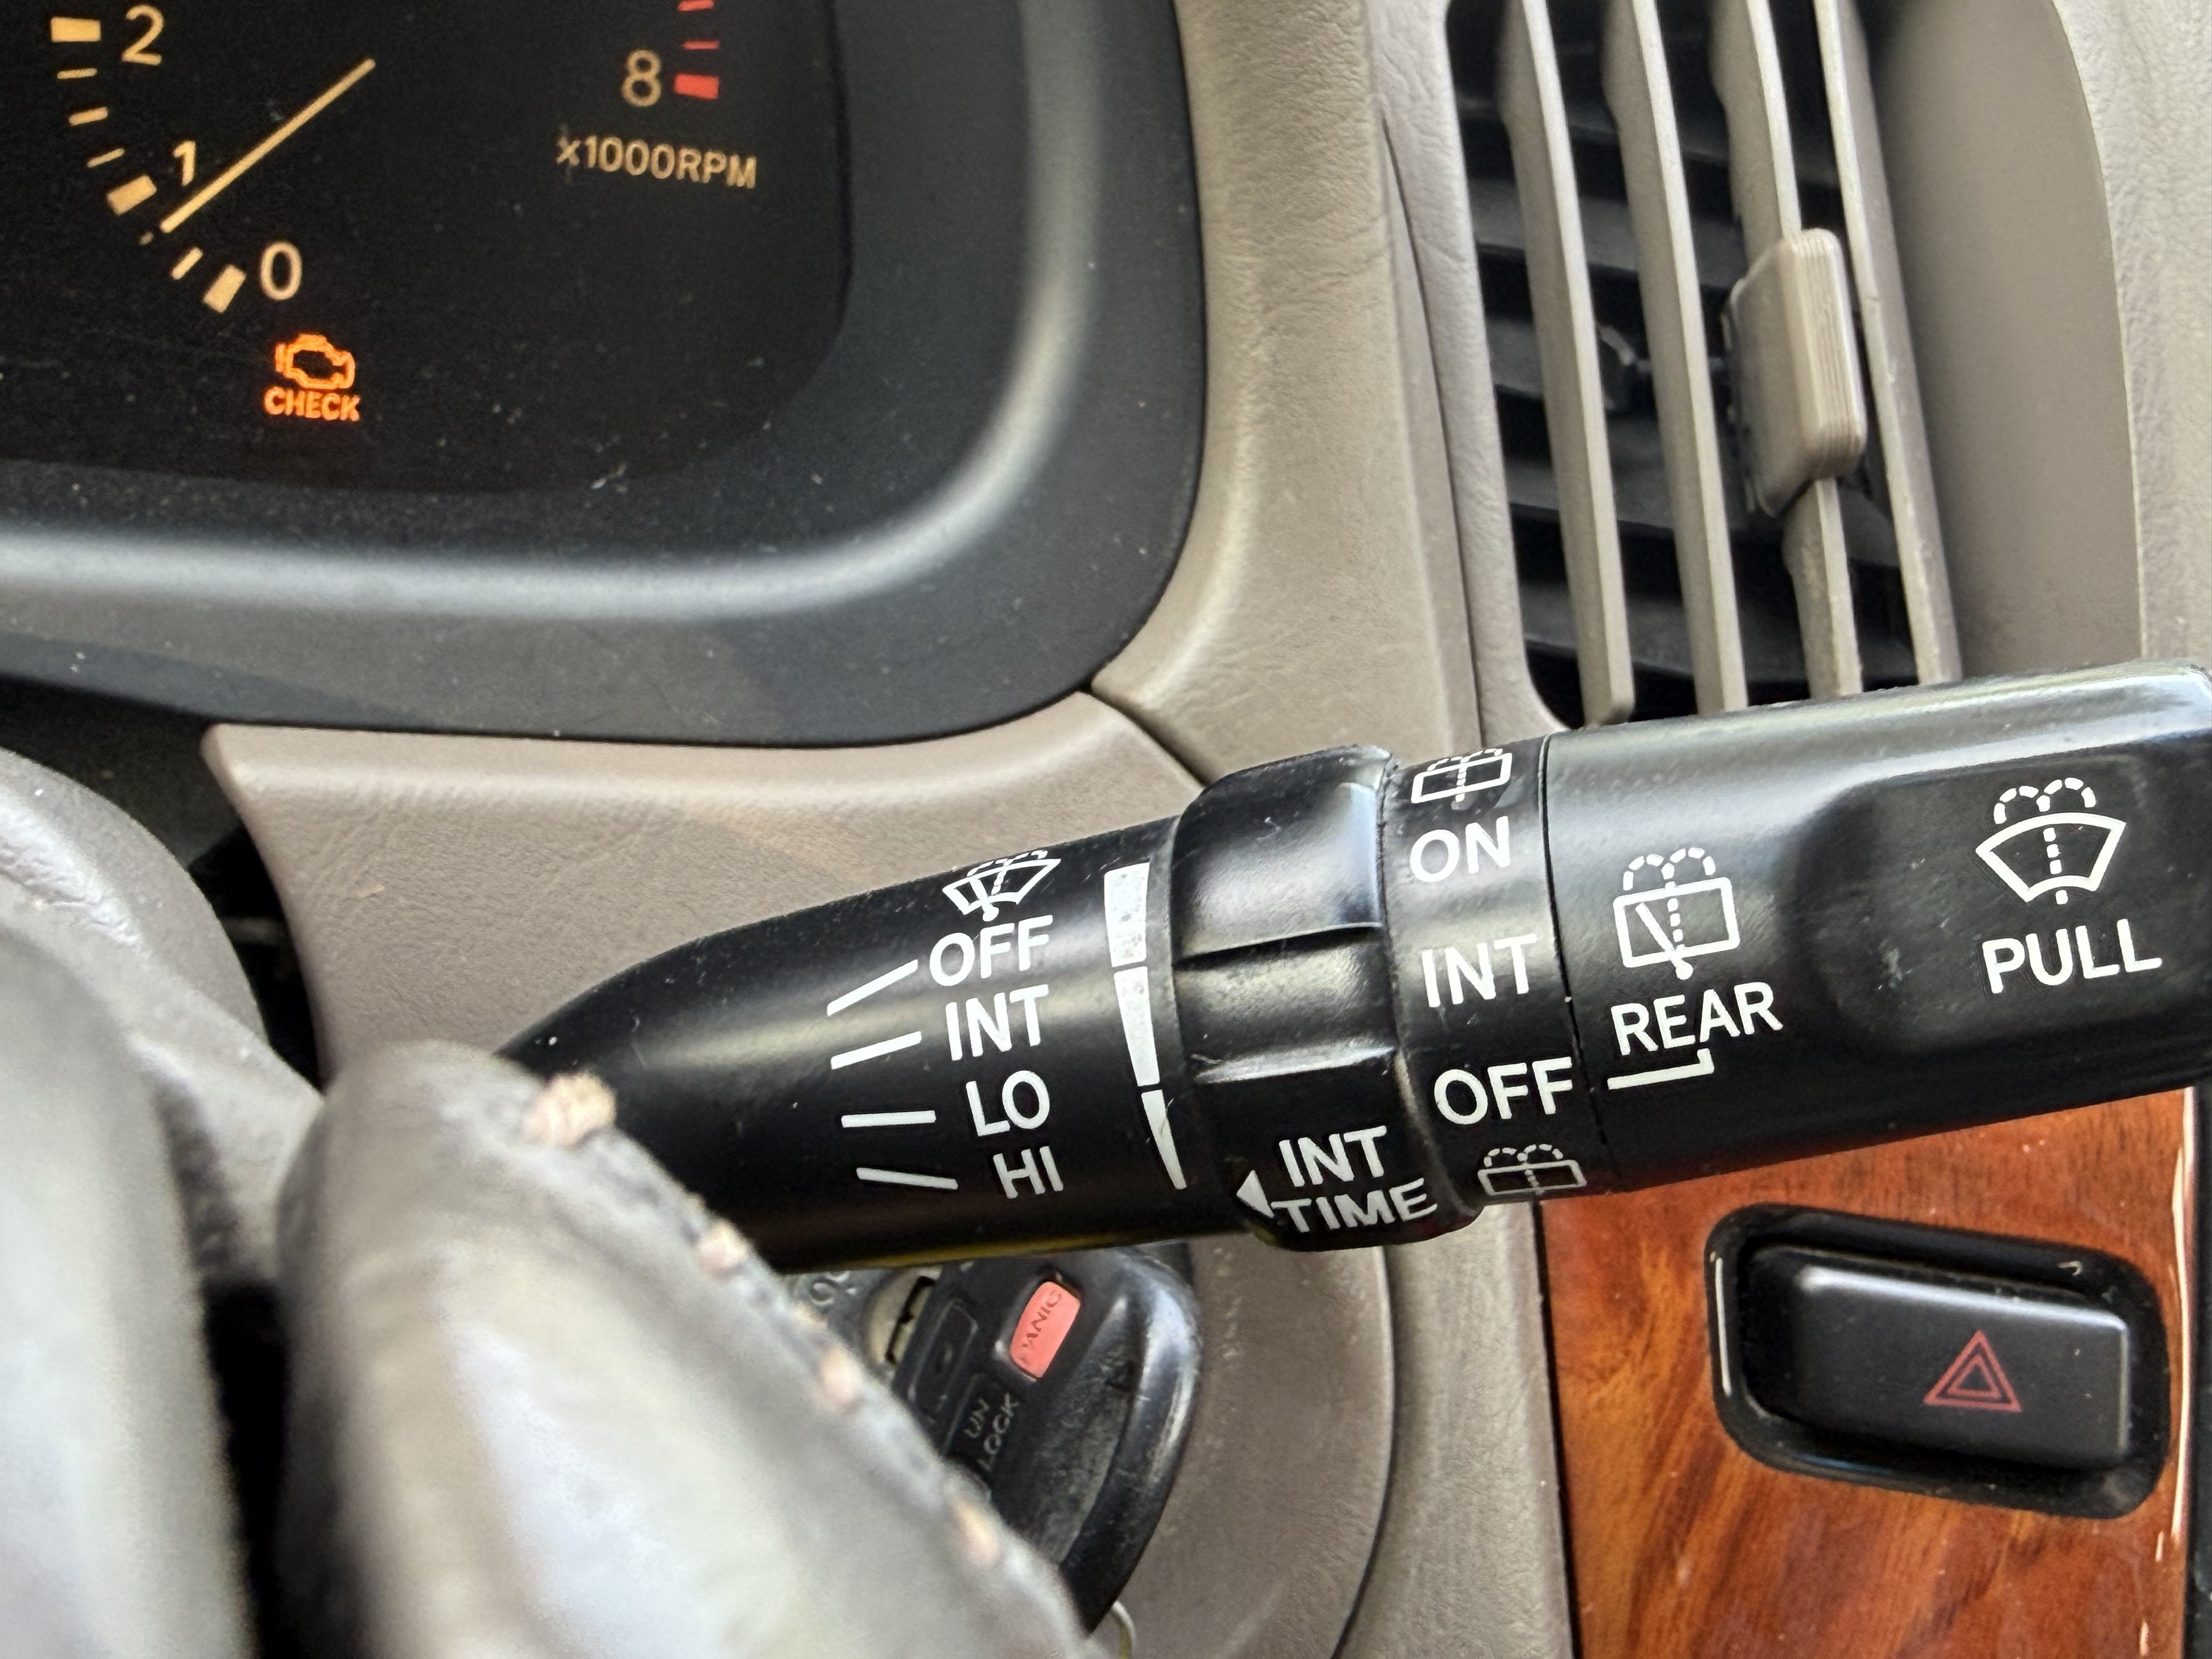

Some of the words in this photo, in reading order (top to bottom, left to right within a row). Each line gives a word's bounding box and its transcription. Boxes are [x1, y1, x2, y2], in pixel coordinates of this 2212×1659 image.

[122, 4, 164, 65] 2
[621, 49, 662, 107] 8
[173, 140, 196, 185] 1
[260, 241, 302, 300] 0
[264, 387, 360, 421] CHECK
[1410, 816, 1510, 882] ON
[929, 915, 1053, 986] OFF
[1421, 934, 1538, 1007] INT
[1981, 918, 2162, 994] PULL
[945, 985, 1049, 1060] INT
[1611, 981, 1783, 1055] REAR
[966, 1070, 1050, 1137] LO
[1434, 1057, 1573, 1125] OFF
[993, 1146, 1064, 1199] HI
[1278, 1126, 1387, 1187] INT
[1271, 1178, 1437, 1233] TIME
[1019, 1289, 1062, 1366] ANIC
[964, 1398, 989, 1438] UN
